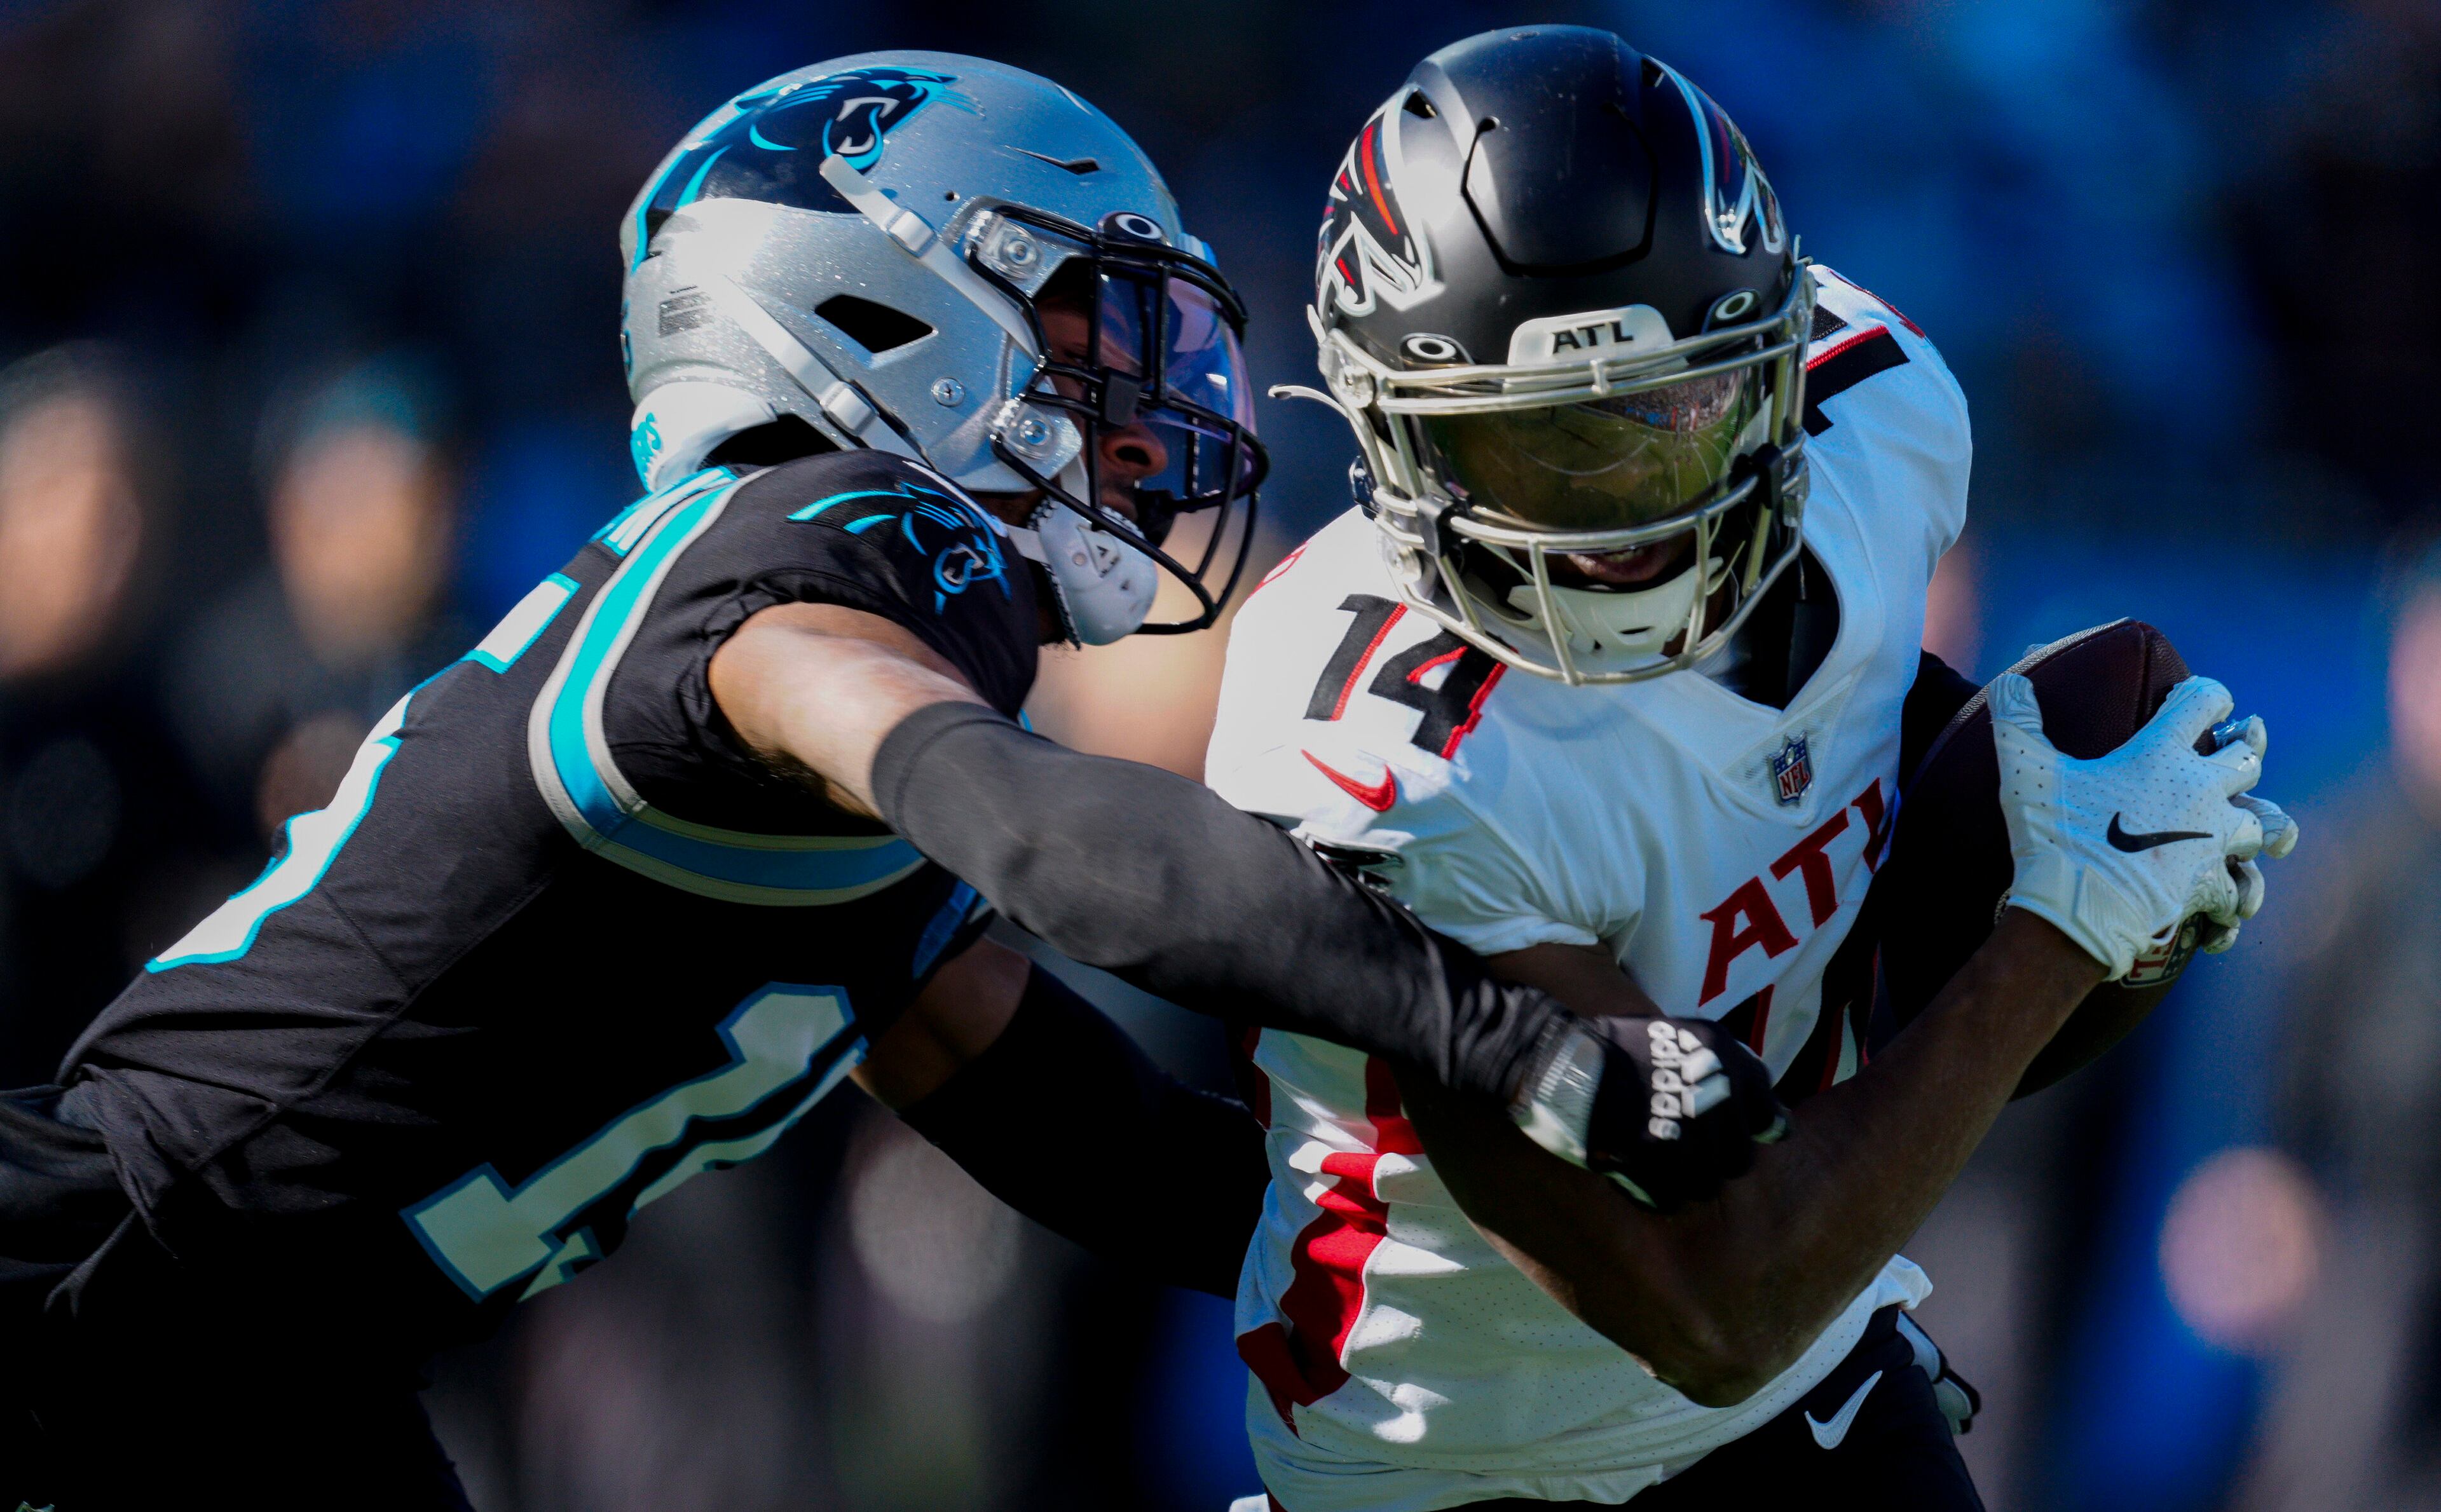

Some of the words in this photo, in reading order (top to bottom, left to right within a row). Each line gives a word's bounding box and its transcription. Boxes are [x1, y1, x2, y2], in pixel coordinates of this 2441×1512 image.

[1551, 320, 1635, 355] ATL
[1303, 594, 1519, 761] 14
[1779, 761, 1810, 797] NFL
[1647, 1020, 1685, 1141] adidas
